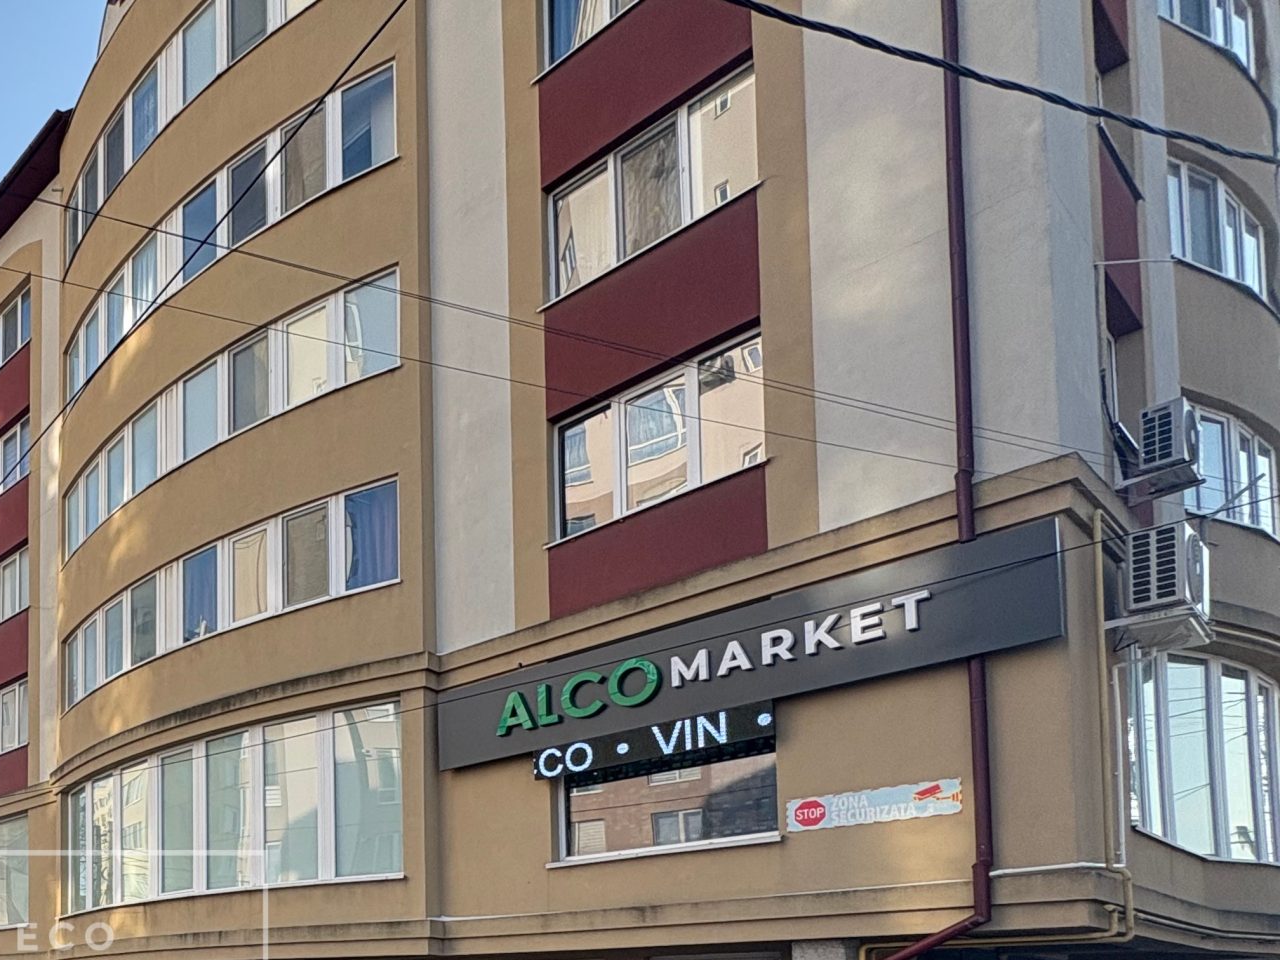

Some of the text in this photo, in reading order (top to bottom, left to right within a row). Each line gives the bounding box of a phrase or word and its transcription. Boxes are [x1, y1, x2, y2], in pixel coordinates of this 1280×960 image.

[533, 711, 728, 778] CO VIN
[831, 794, 869, 811] ZONA
[795, 807, 825, 821] STOP
